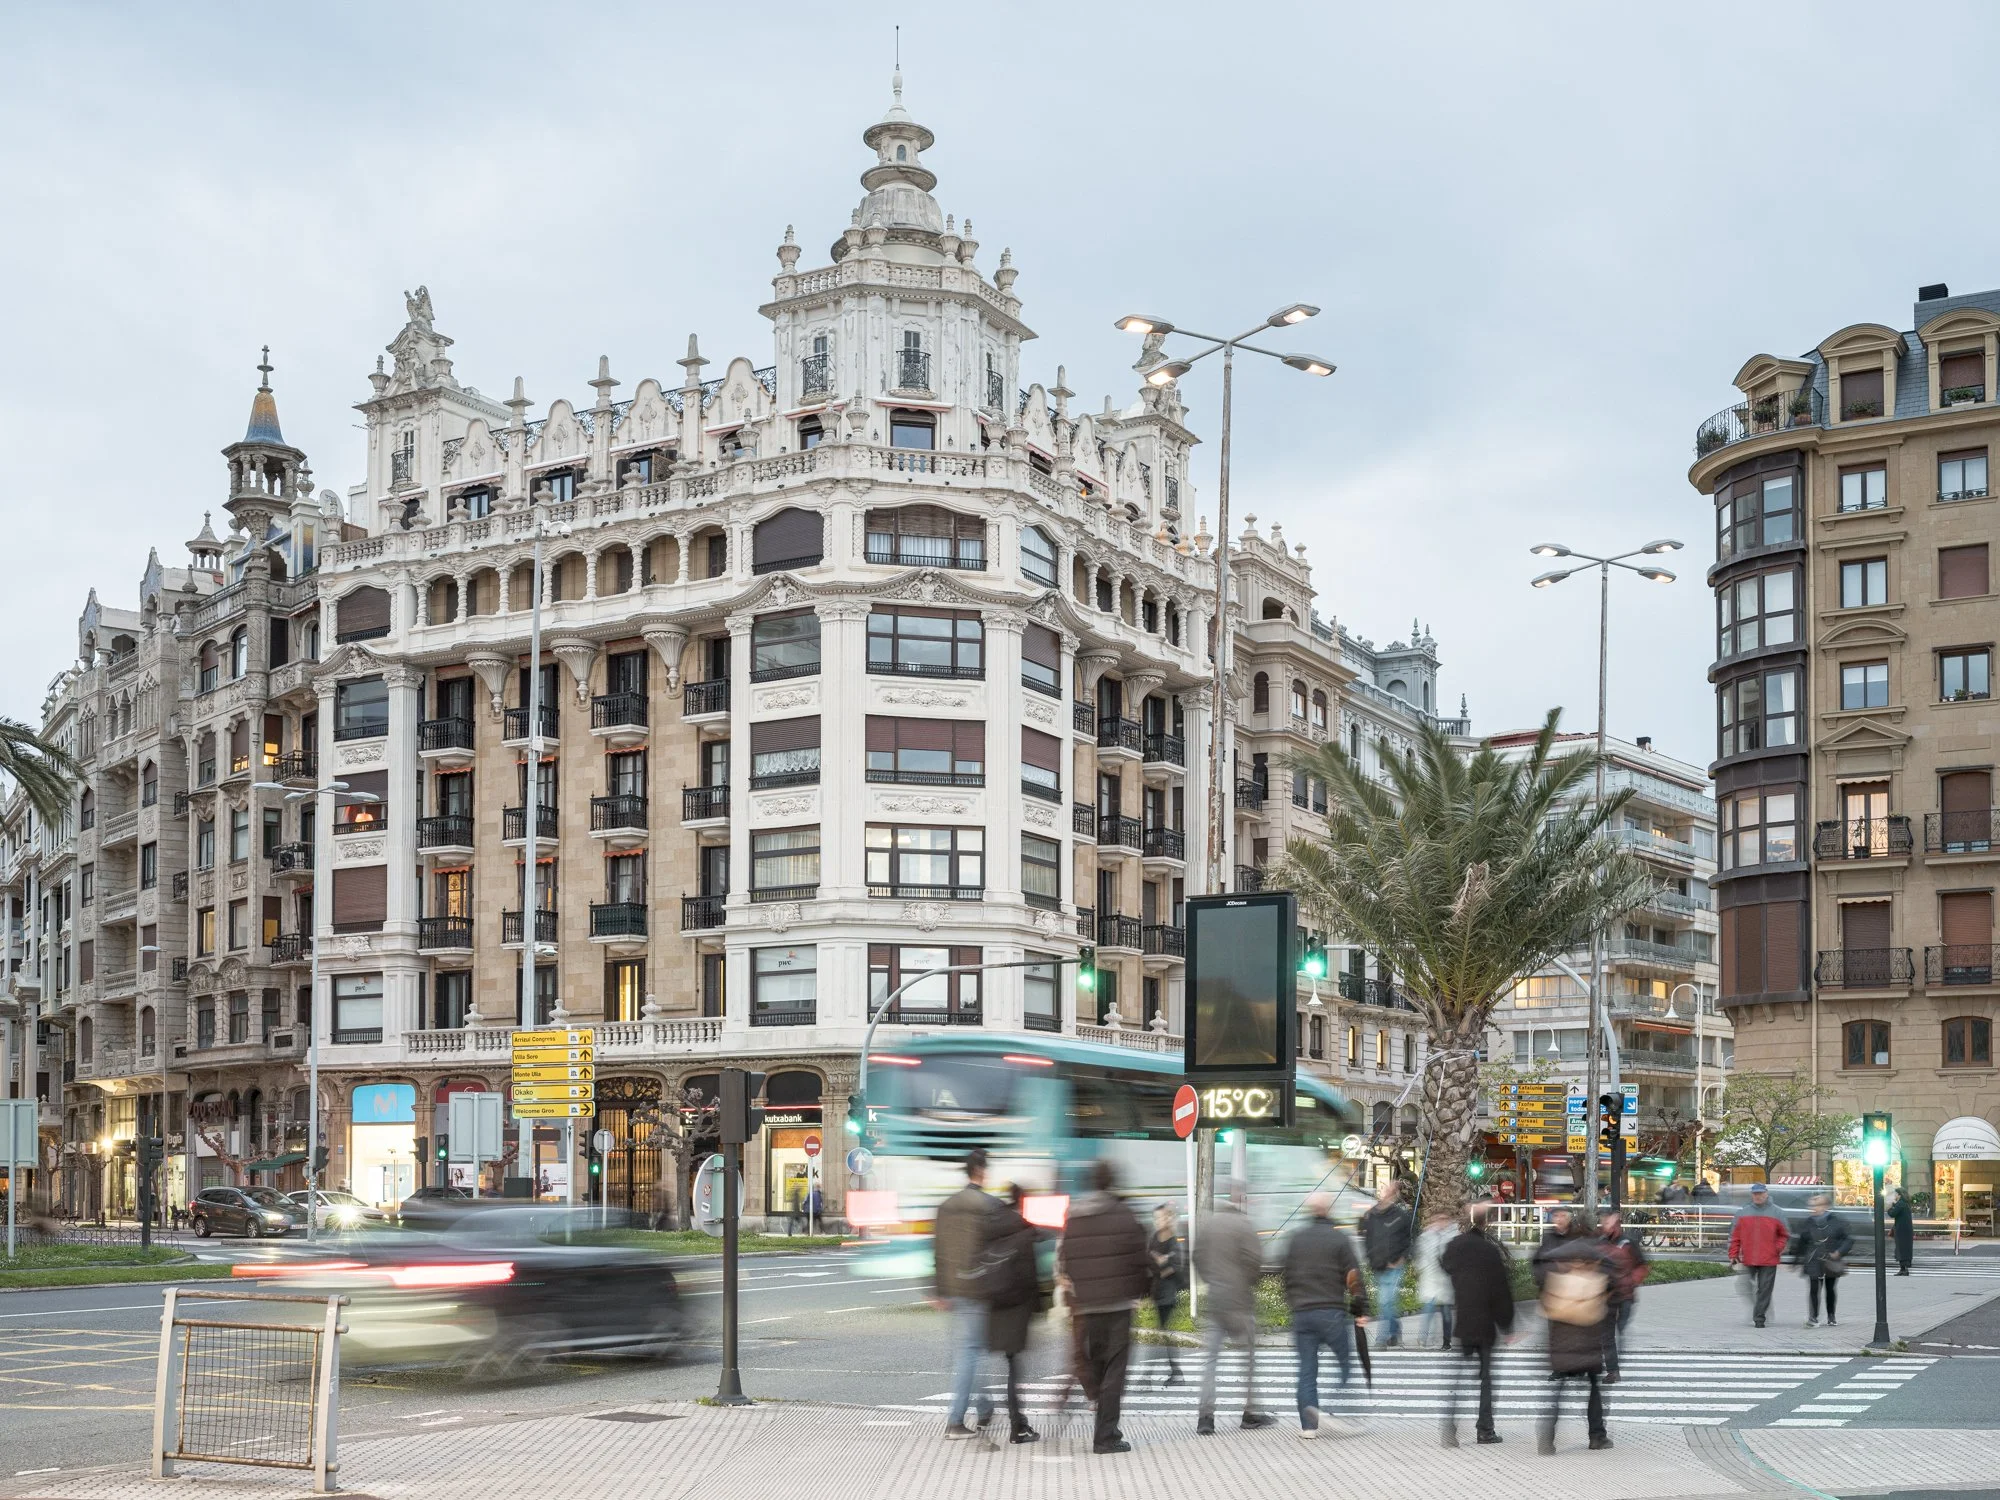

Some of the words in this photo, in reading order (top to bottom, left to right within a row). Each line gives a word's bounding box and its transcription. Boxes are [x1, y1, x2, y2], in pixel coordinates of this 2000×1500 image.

[778, 960, 792, 968] pwc
[514, 1088, 534, 1096] Okako
[1621, 1085, 1636, 1093] Gros
[1202, 1087, 1267, 1118] 15°C
[764, 1114, 803, 1123] kutxabank
